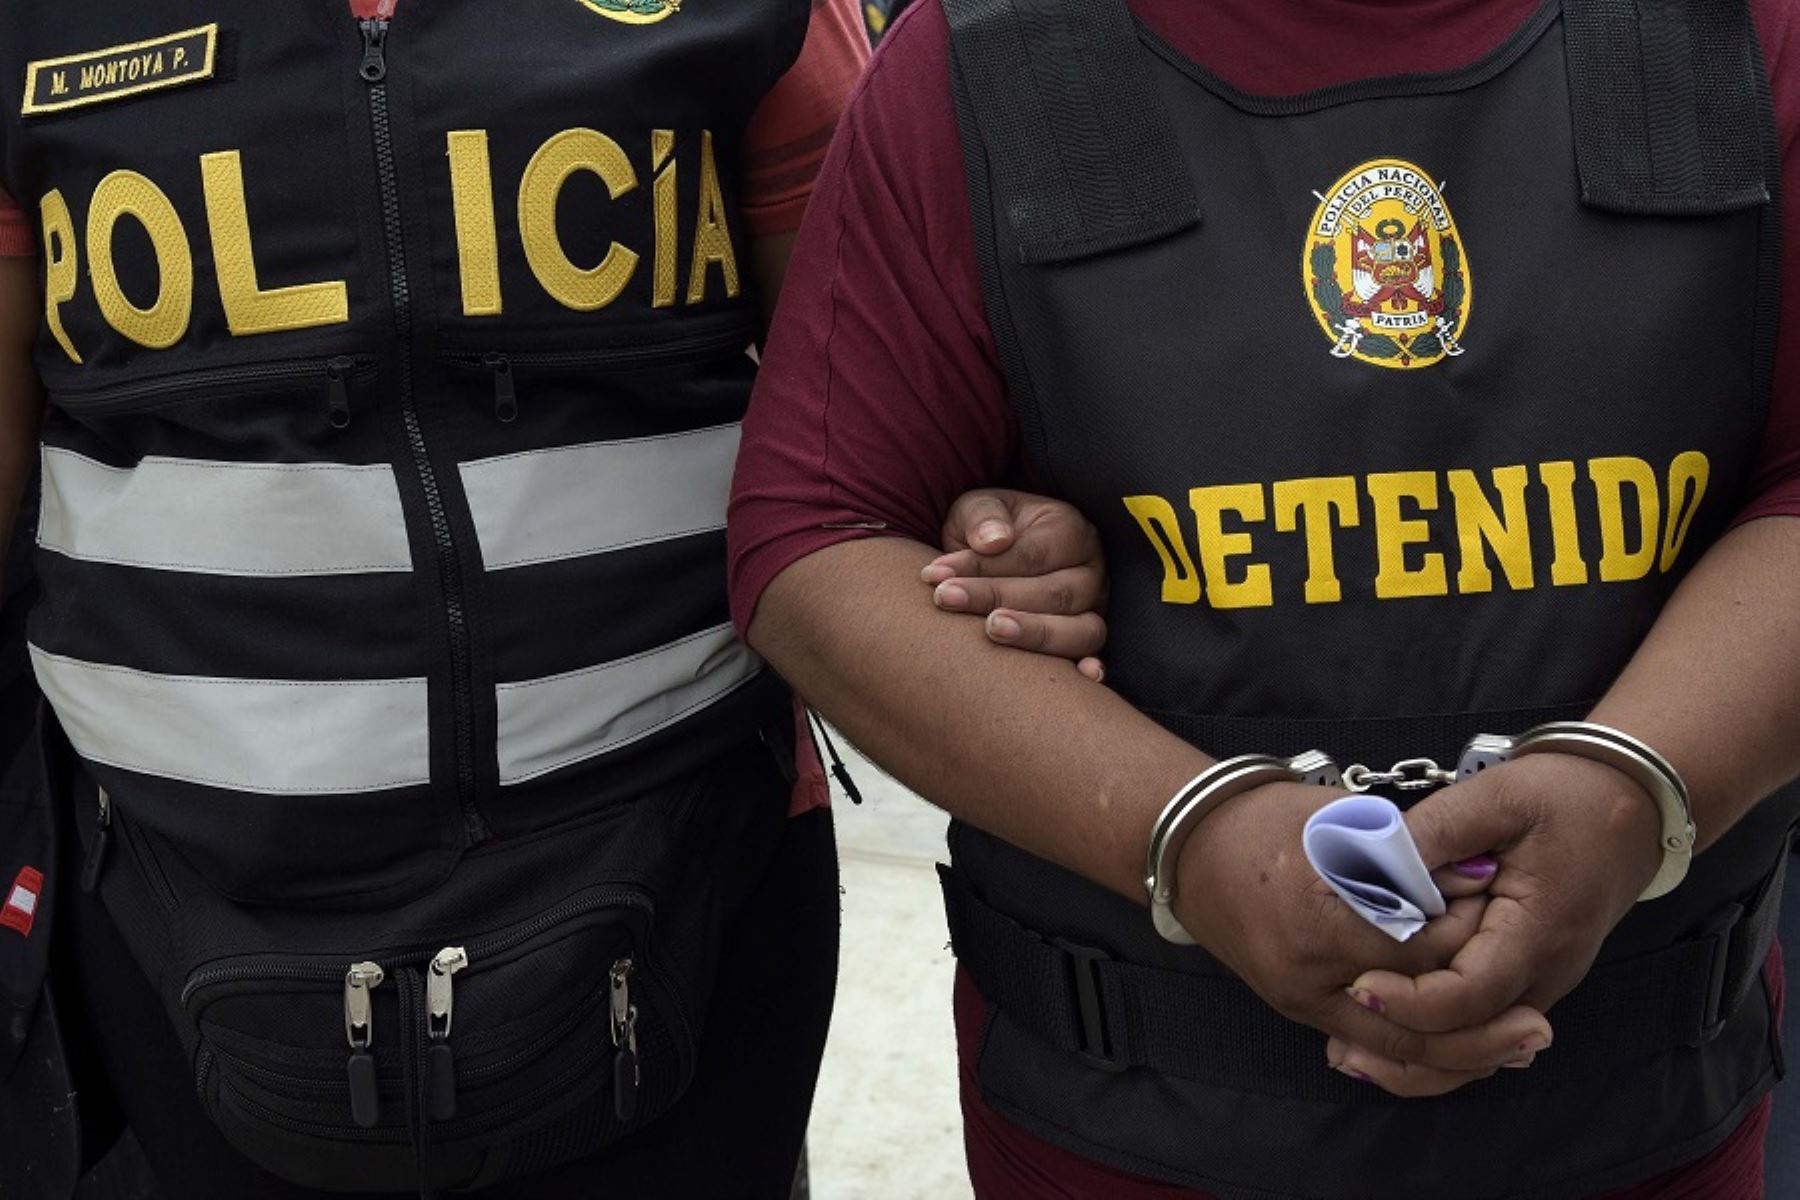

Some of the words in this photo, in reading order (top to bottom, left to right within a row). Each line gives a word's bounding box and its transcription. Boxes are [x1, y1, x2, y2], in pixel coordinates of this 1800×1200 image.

[51, 71, 70, 96] M.
[79, 51, 163, 90] MONTOYA
[172, 47, 189, 70] P.
[1320, 174, 1373, 233] POLICIA
[1377, 168, 1447, 228] NACIONAL
[1351, 190, 1379, 213] DEL
[1383, 186, 1422, 208] PERU
[1375, 314, 1427, 327] PATRIA
[1122, 450, 1710, 608] DETENIDO
